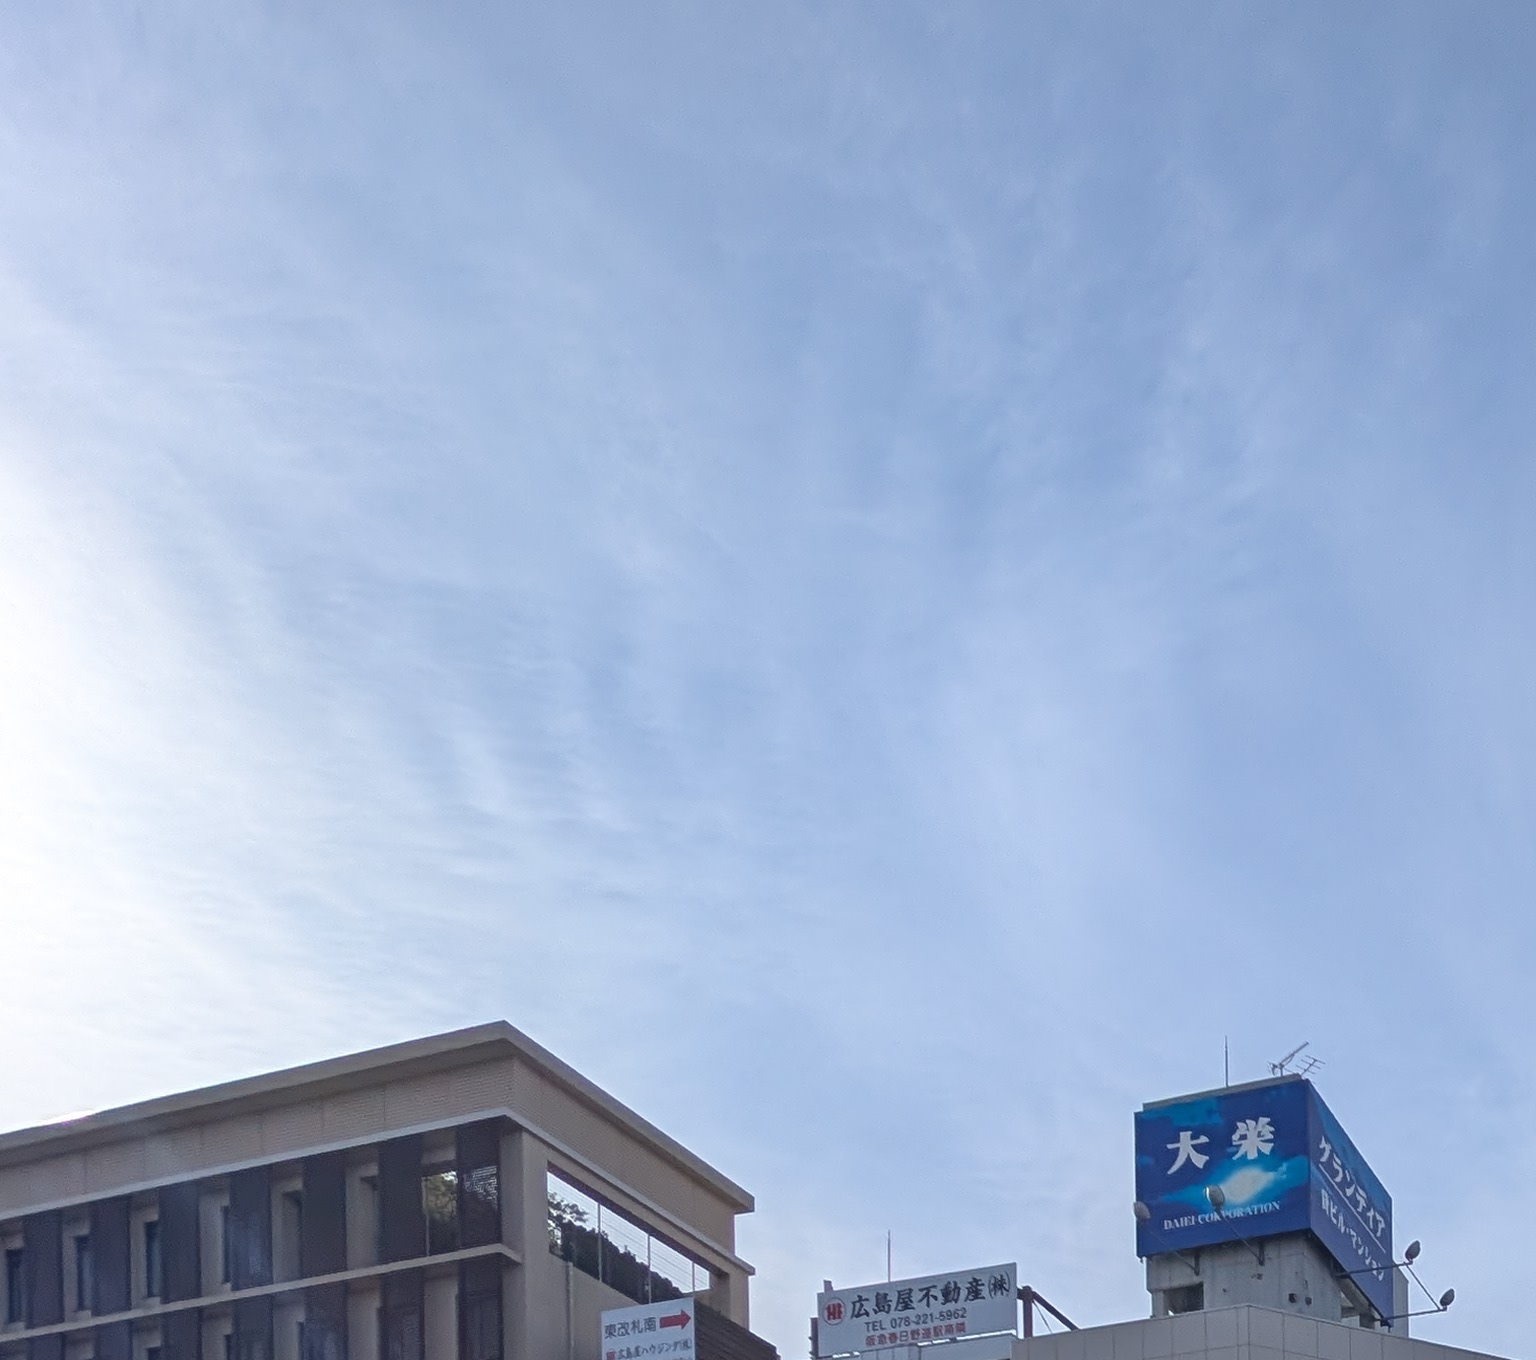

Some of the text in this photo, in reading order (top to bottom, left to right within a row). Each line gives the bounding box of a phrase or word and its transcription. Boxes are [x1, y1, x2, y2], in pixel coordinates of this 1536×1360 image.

[1166, 1116, 1275, 1175] 大栄
[1163, 1214, 1196, 1231] DAIEI
[864, 1307, 967, 1333] TEL 078-221-5962
